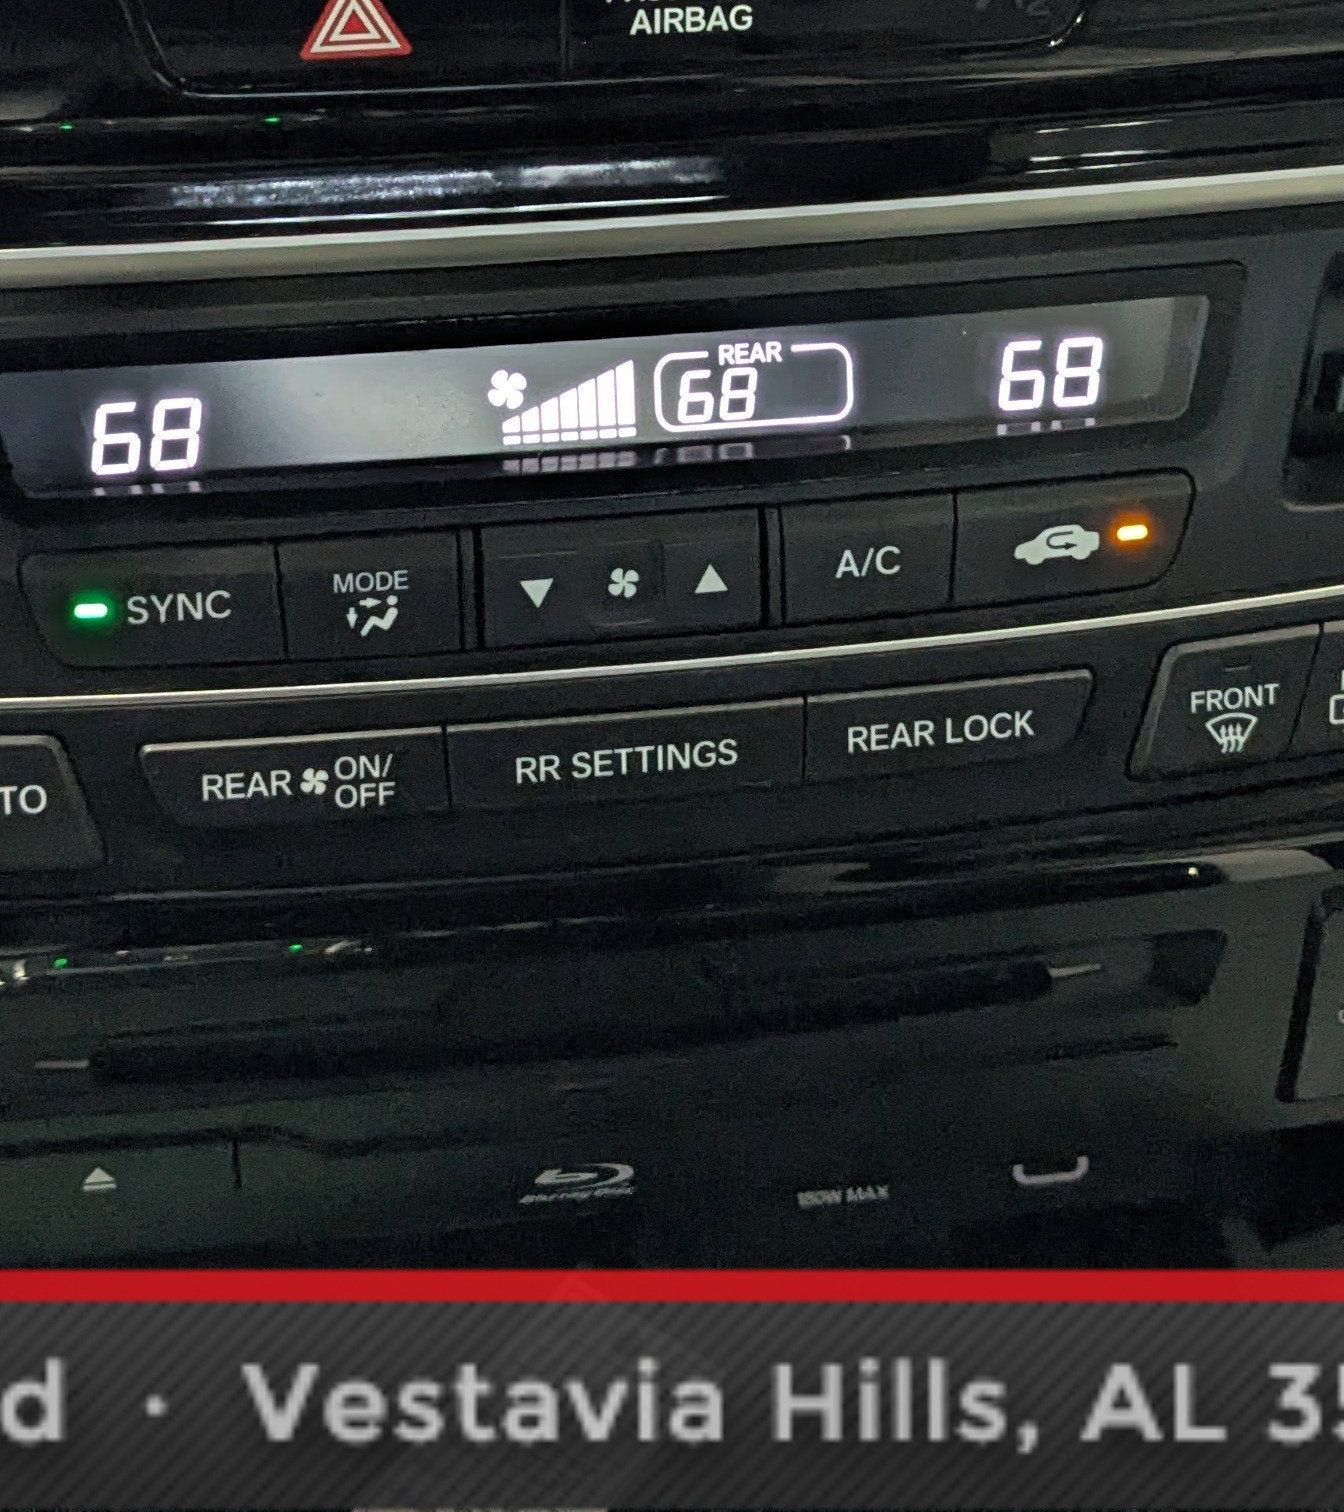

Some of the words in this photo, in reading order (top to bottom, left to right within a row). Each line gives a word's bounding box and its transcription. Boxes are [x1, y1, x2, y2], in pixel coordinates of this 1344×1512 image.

[628, 4, 755, 37] AIRBAG
[716, 340, 784, 368] REAR
[996, 334, 1106, 413] 68
[675, 368, 760, 425] 68
[89, 394, 205, 477] 68
[834, 545, 902, 580] A/C
[332, 569, 410, 595] MODE
[126, 589, 233, 625] SYNC
[1188, 682, 1282, 716] FRONT
[844, 719, 936, 755] REAR
[942, 708, 1037, 746] LOCK
[331, 752, 396, 782] ON/
[514, 755, 564, 786] RR
[570, 737, 741, 782] SETTINGS
[199, 767, 295, 804] REAR
[332, 780, 398, 811] OFF
